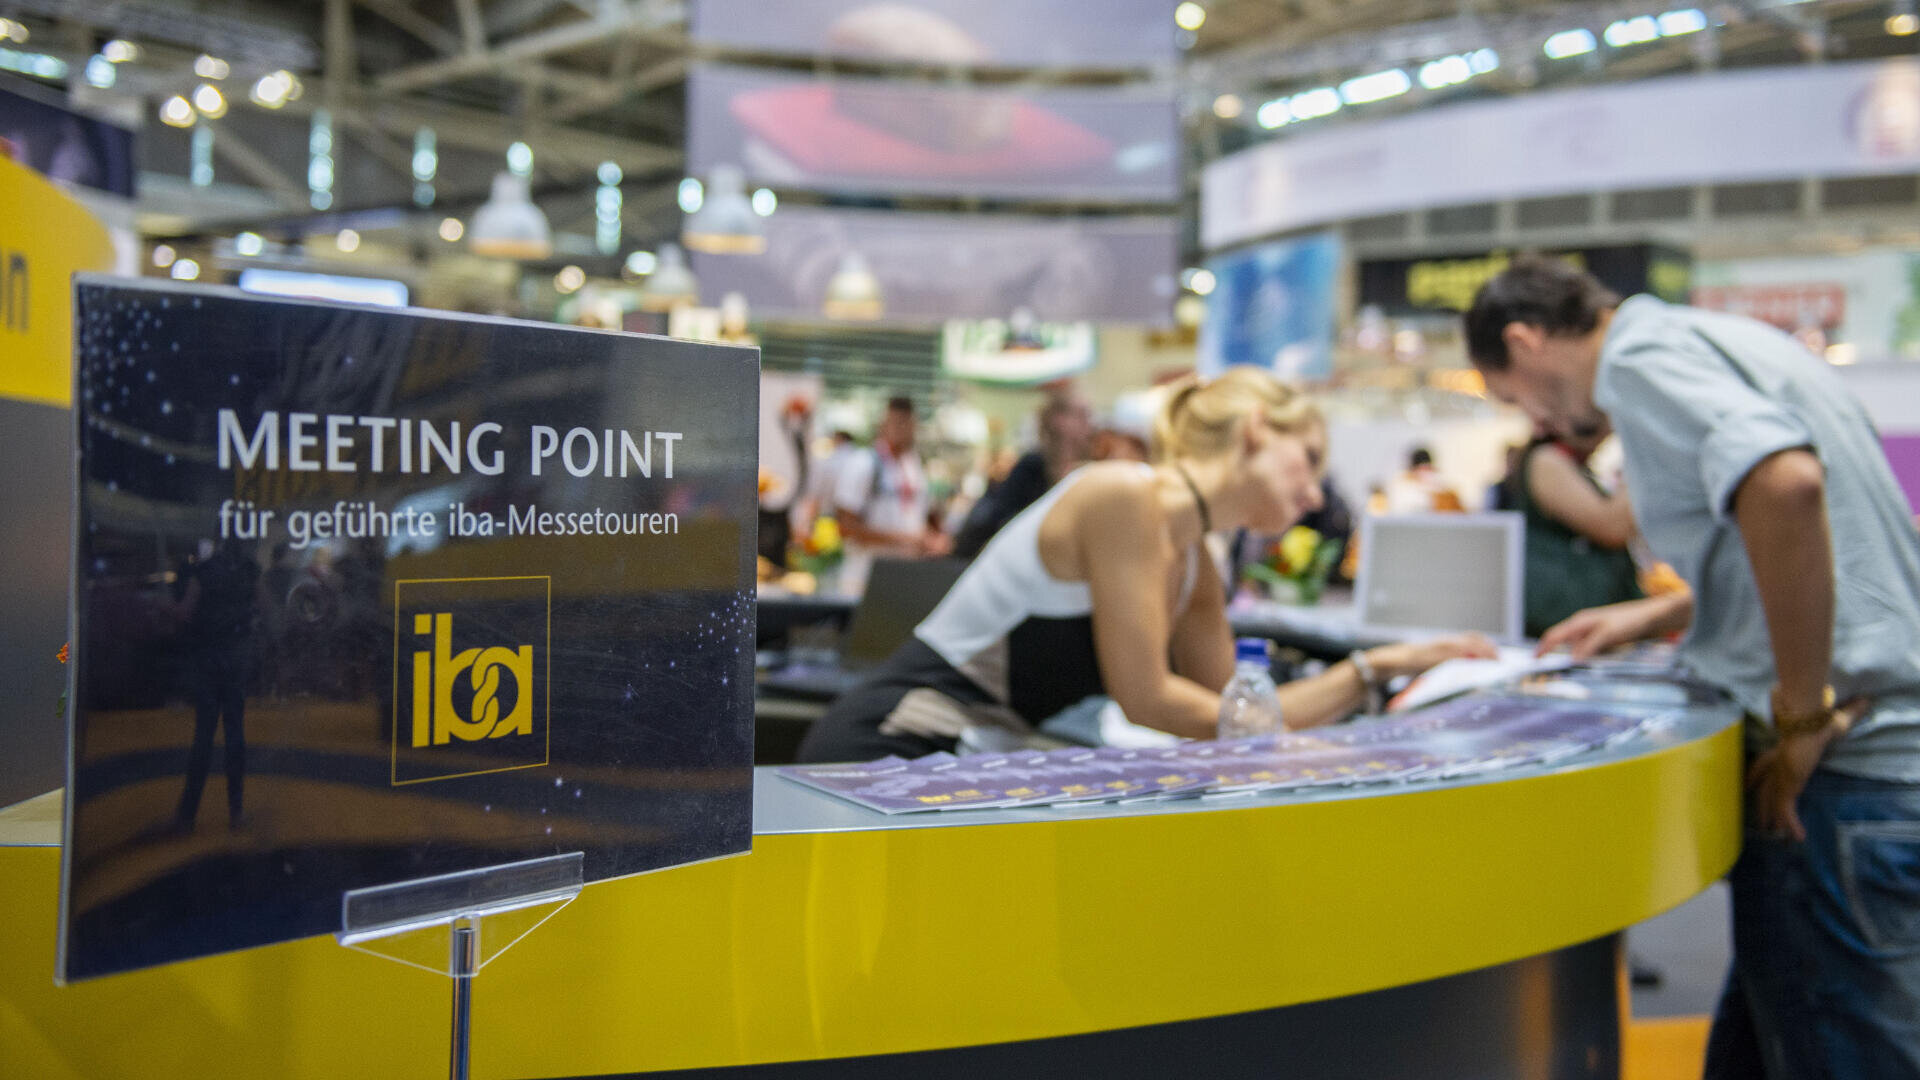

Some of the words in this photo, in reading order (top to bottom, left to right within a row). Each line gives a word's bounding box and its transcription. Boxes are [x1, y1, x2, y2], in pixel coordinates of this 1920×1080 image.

[218, 408, 505, 476] MEETING
[531, 424, 684, 479] POINT
[219, 499, 275, 539] für
[287, 500, 437, 550] geführte
[448, 501, 679, 537] iba-Messetouren
[412, 612, 534, 748] iba
